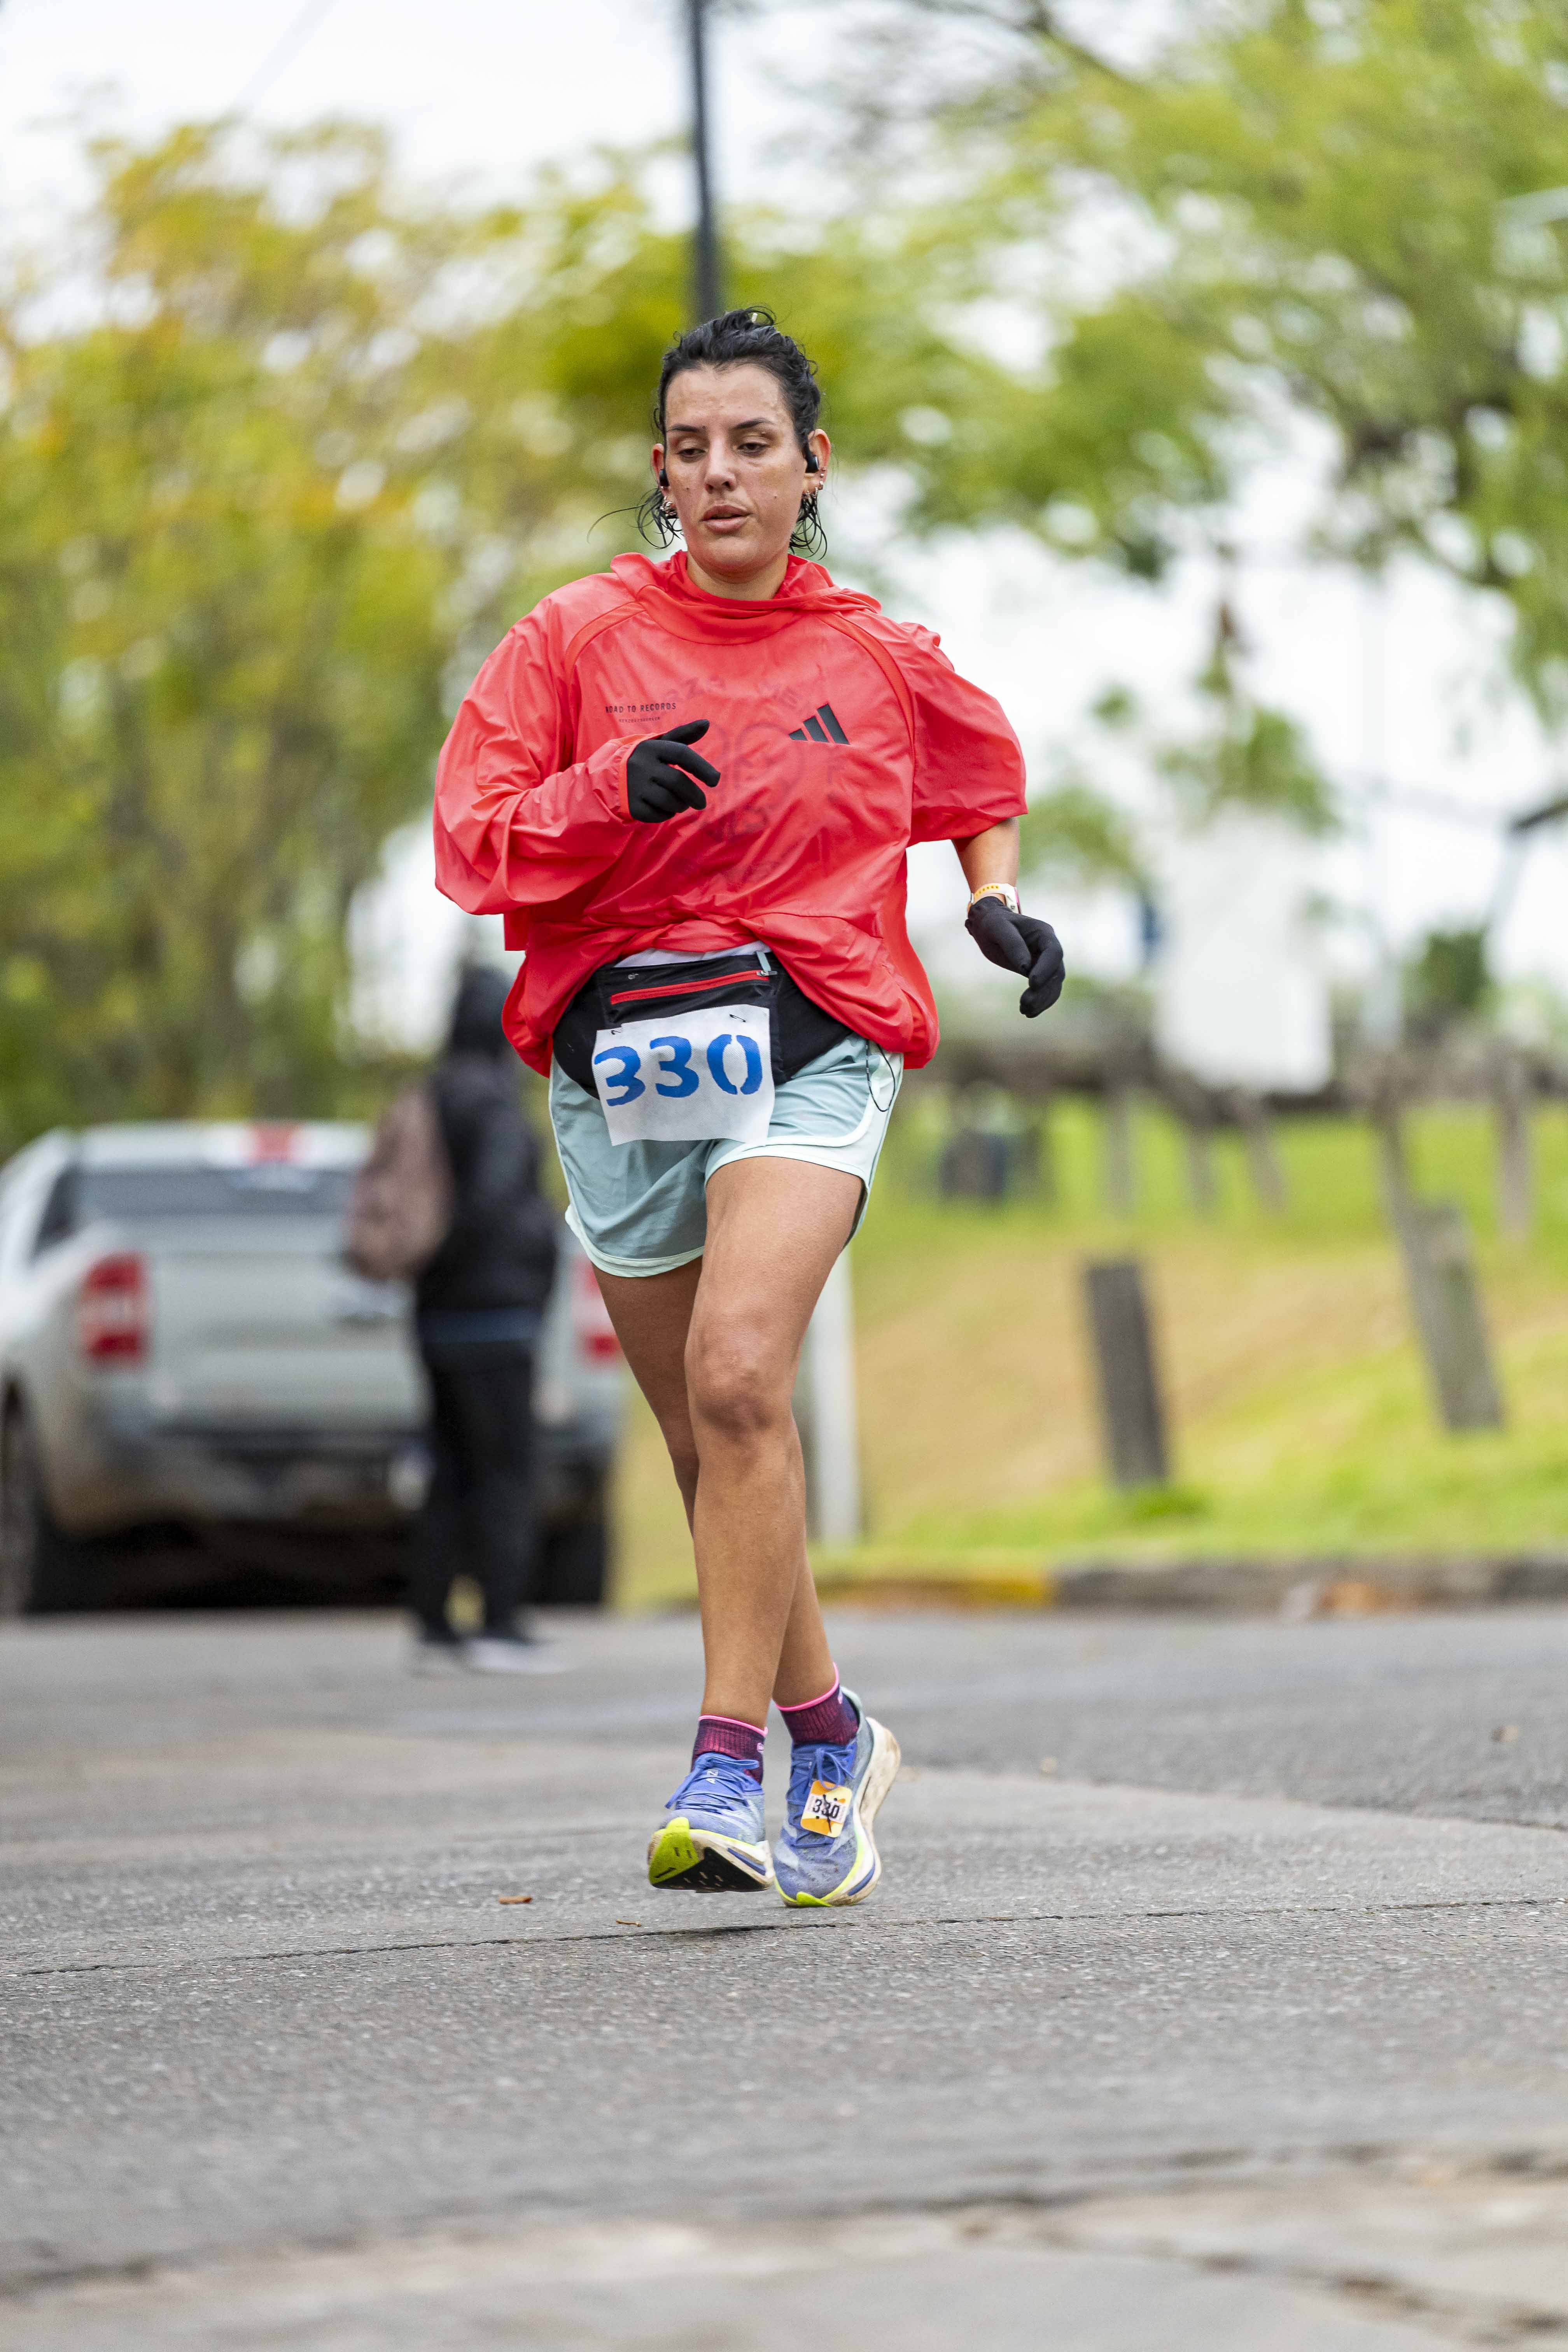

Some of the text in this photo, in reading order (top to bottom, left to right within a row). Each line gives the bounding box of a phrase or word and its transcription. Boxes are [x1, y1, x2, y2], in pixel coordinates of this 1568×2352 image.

[640, 702, 676, 712] RECORDS
[594, 1033, 763, 1107] 330
[812, 1799, 840, 1818] 330
